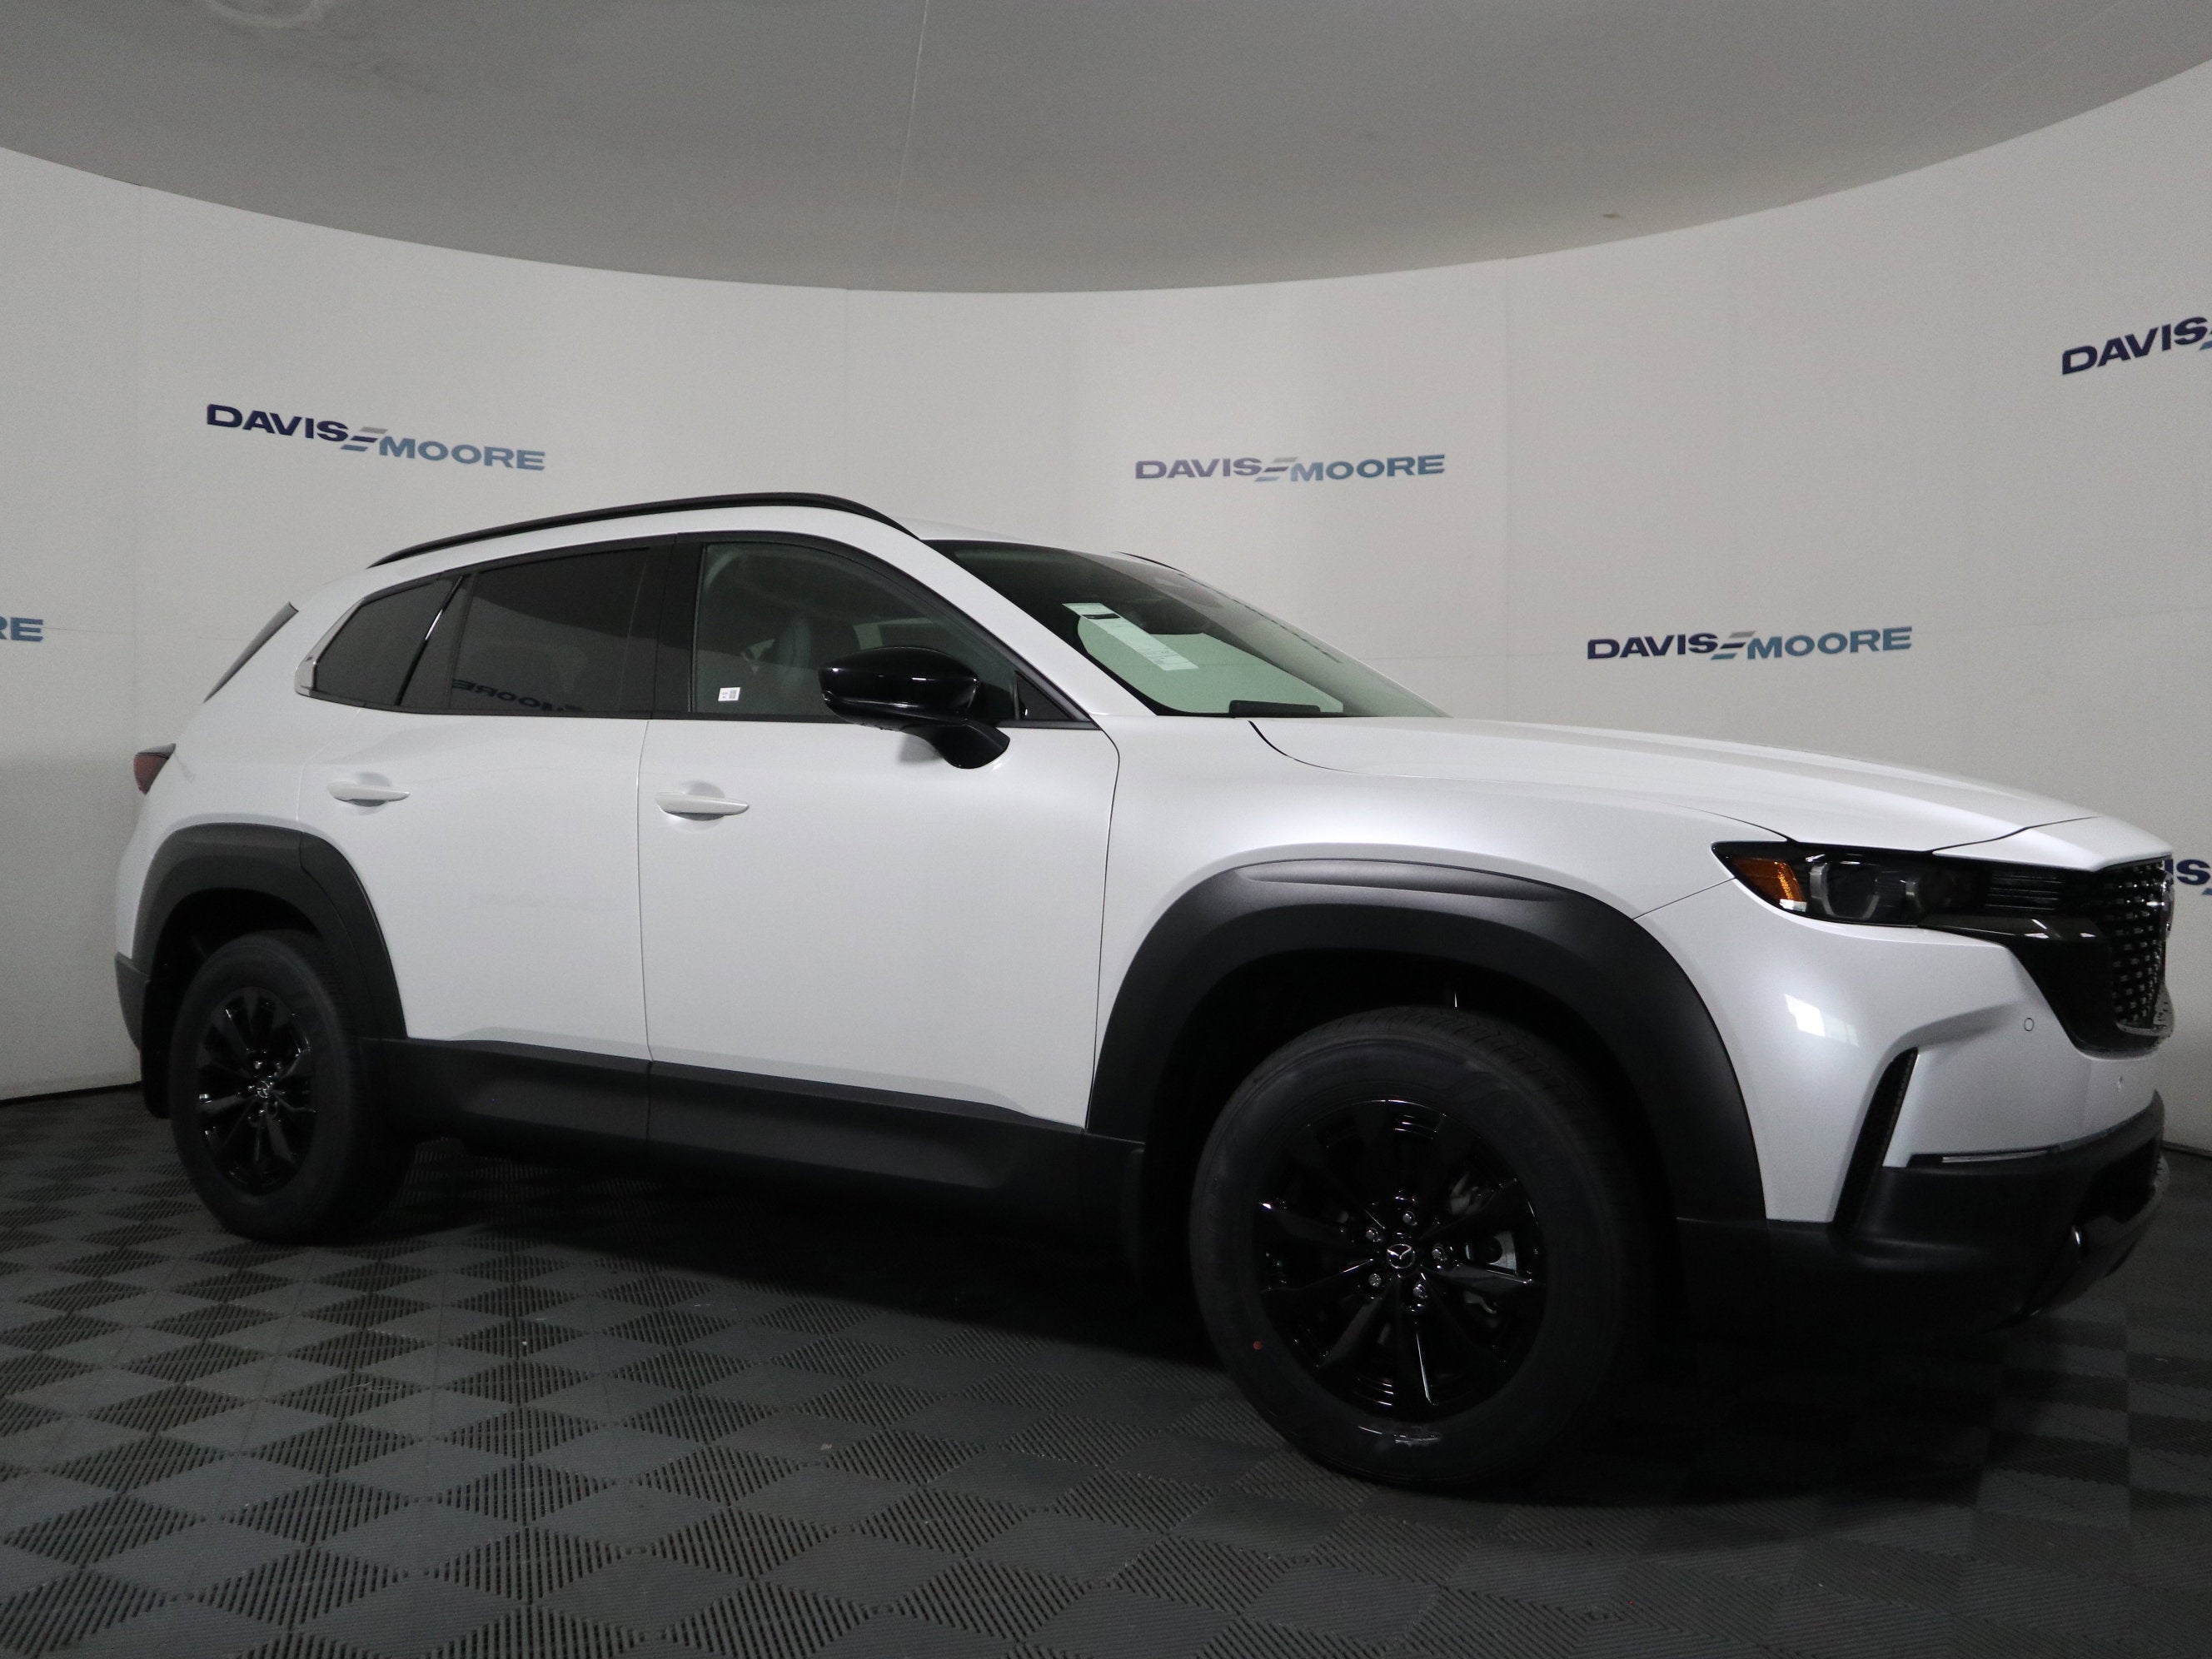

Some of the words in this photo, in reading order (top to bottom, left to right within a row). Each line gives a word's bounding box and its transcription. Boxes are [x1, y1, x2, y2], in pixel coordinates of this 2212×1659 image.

[2062, 316, 2208, 376] DAVIS
[207, 404, 349, 442] DAVIS
[379, 436, 546, 471] MOORE
[1135, 458, 1260, 480] DAVIS
[1290, 454, 1445, 482] MOORE
[1587, 633, 1717, 660] DAVIS
[1747, 625, 1912, 660] MOORE
